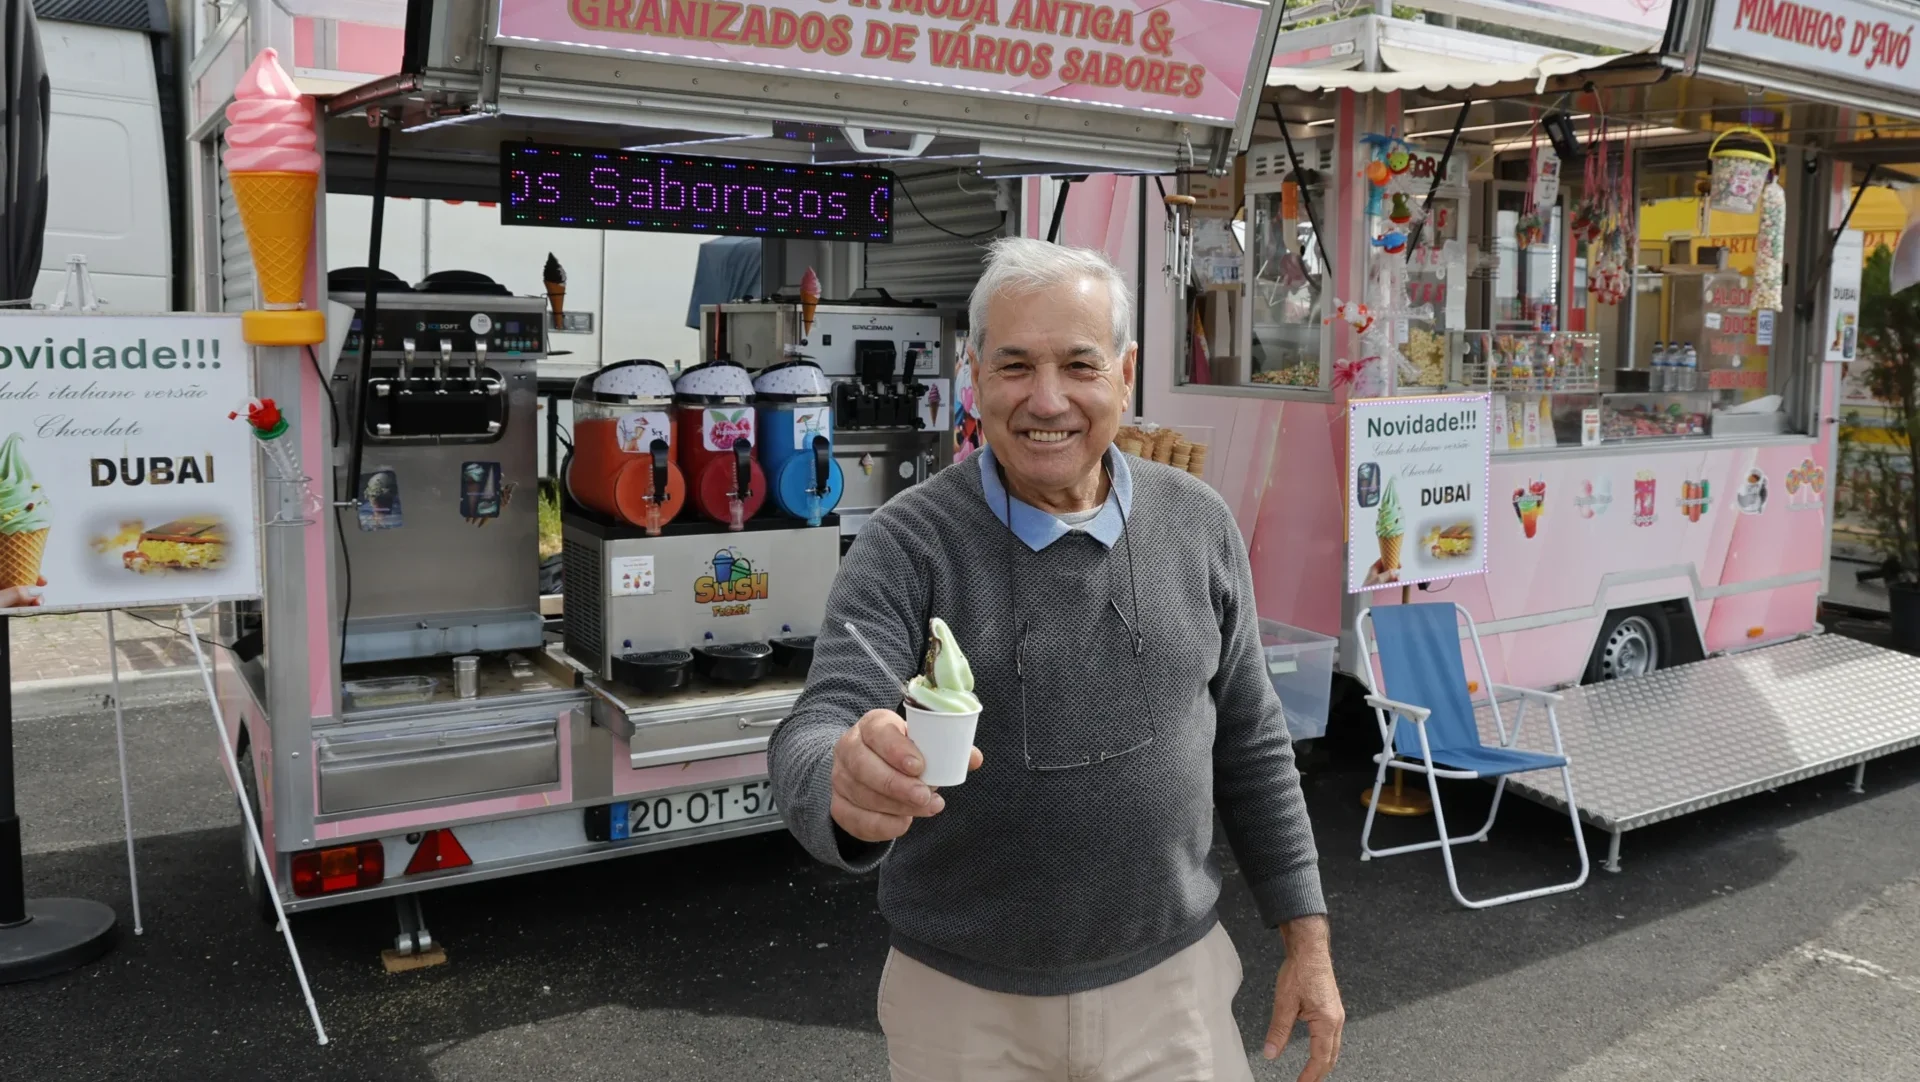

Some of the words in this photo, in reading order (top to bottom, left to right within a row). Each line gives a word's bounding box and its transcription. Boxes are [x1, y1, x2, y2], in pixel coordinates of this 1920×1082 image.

[1005, 0, 1134, 46] ANTIGA
[1140, 8, 1175, 57] &
[1734, 0, 1846, 53] MIMINHOS
[1848, 19, 1915, 70] D'AVÓ
[567, 0, 854, 57] GRANIZADOS
[861, 19, 920, 63] DE
[928, 22, 1054, 80] VÁRIOS
[1059, 46, 1206, 99] SABORES
[589, 166, 848, 220] Saborosos
[47, 381, 137, 400] italiano
[144, 384, 208, 399] versão
[33, 413, 144, 438] Chocolate
[1367, 410, 1477, 438] Novidade!!!
[89, 454, 215, 487] DUBAI
[1400, 462, 1444, 479] Chocolate
[1421, 483, 1471, 507] DUBAI
[693, 571, 769, 605] SLUSH
[711, 603, 751, 617] FROZEN
